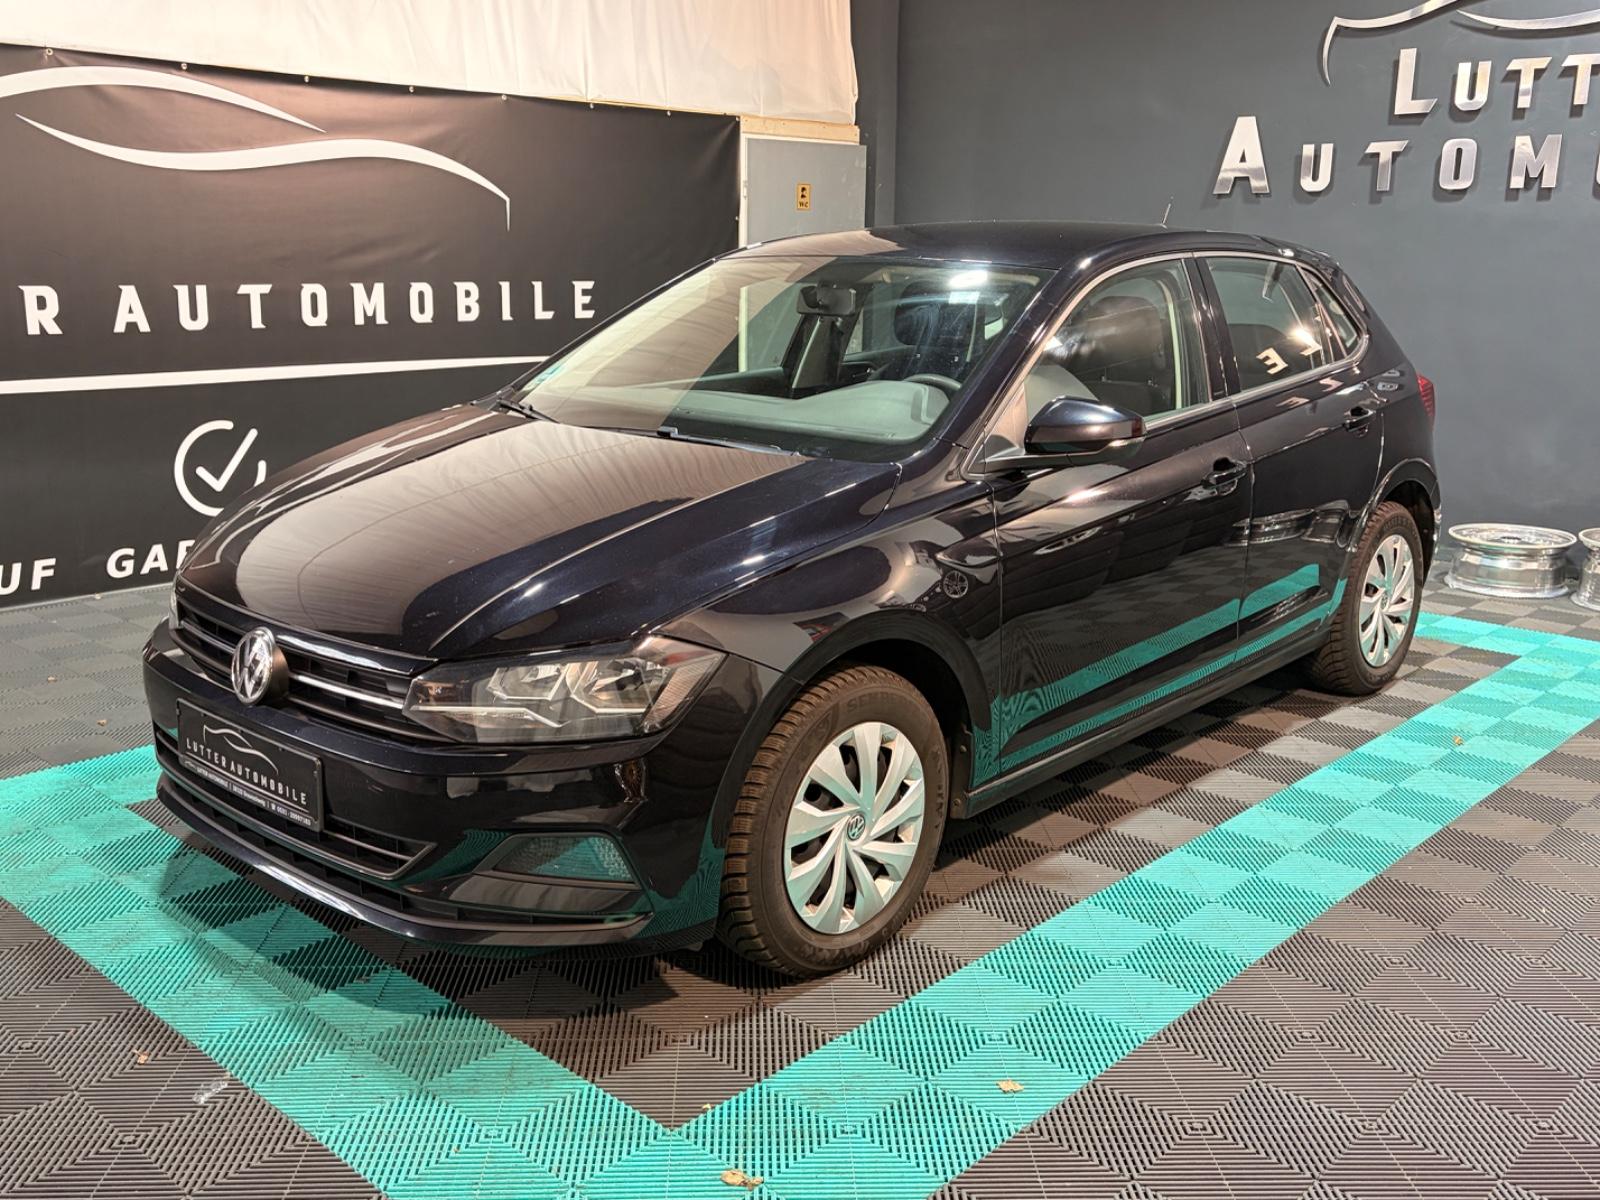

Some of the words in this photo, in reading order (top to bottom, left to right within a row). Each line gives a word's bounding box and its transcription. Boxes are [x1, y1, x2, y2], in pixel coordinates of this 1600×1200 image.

[1212, 116, 1600, 194] AUTOM
[113, 280, 596, 333] AUTOMOBILE
[186, 737, 226, 768] LUTTER
[230, 760, 307, 805] AUTOMOBILE
